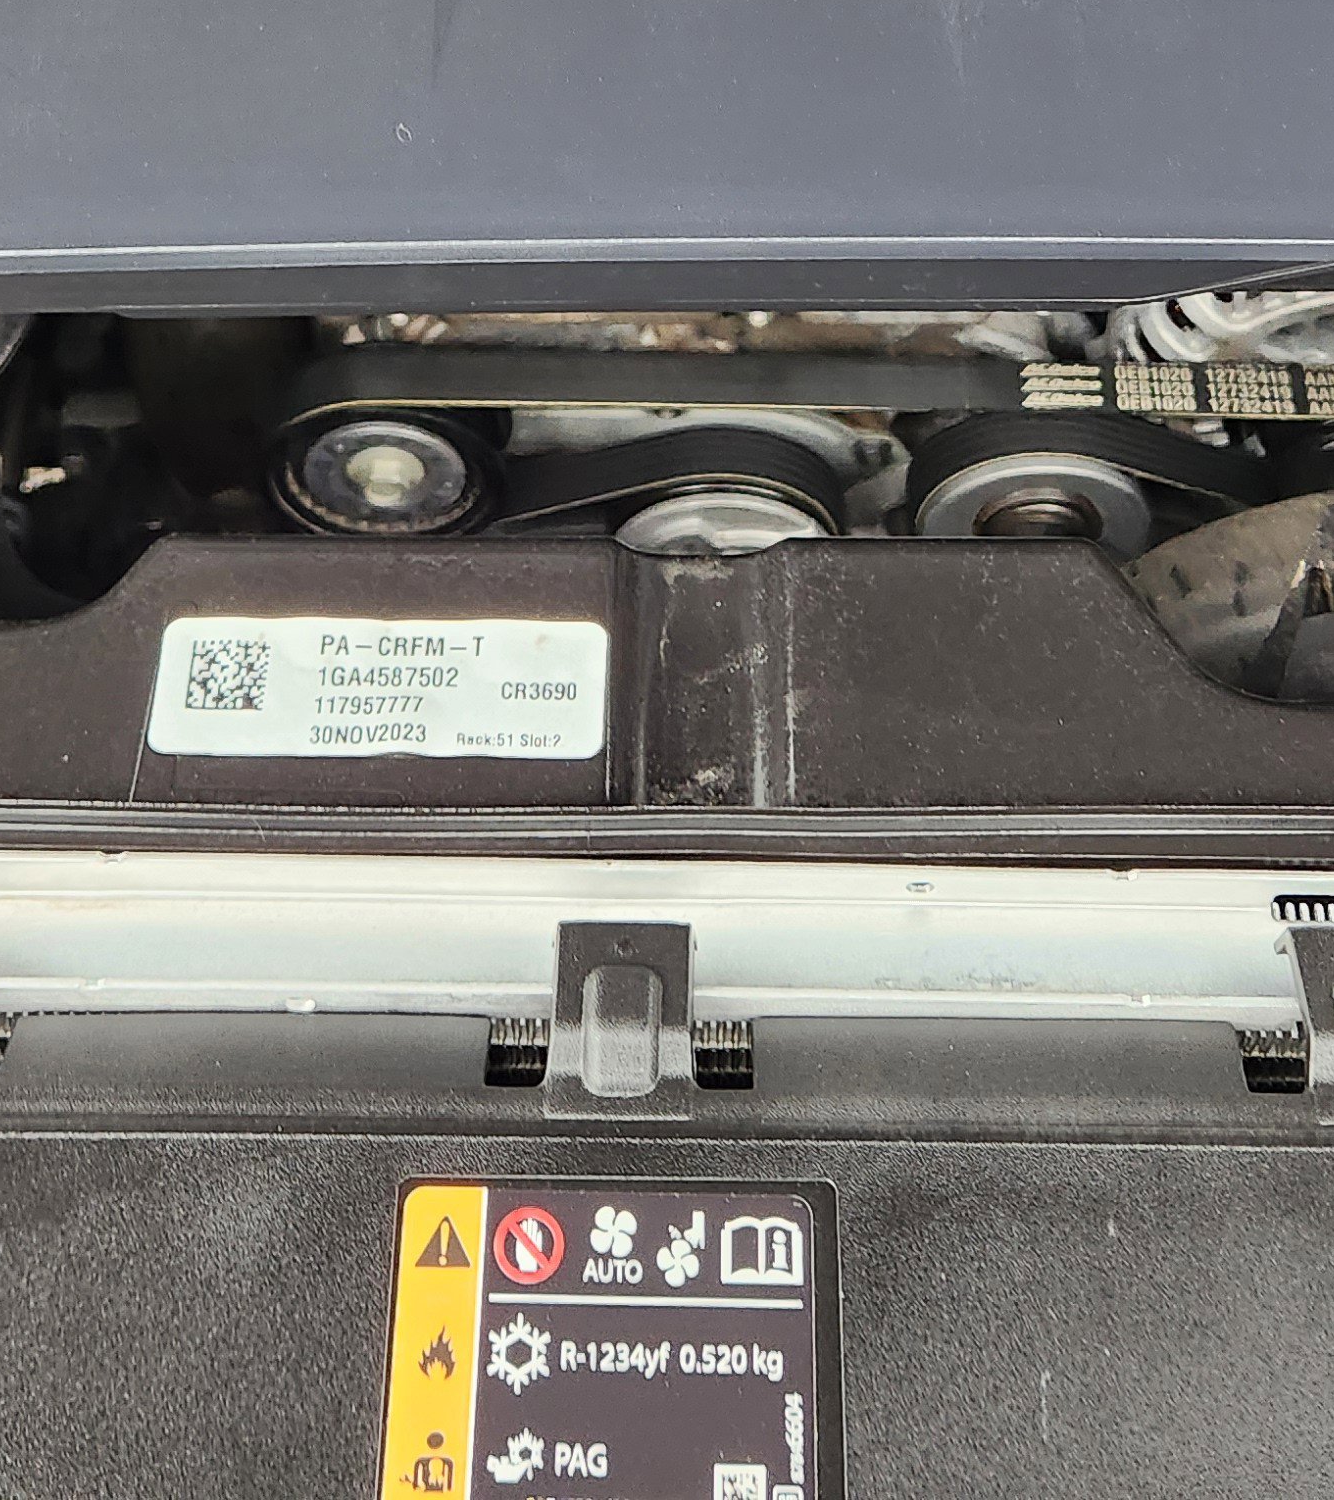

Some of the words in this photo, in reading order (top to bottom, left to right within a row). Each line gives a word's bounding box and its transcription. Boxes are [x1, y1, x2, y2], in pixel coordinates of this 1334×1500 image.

[318, 666, 459, 688] 1GA4587502
[501, 681, 578, 701] CR3690
[315, 695, 424, 715] 117957777
[309, 723, 428, 744] 30NOV2023
[456, 732, 513, 747] Rack:51
[582, 1258, 643, 1284] AUTO
[560, 1340, 671, 1380] R-1234yf
[679, 1343, 748, 1375] 0.520
[752, 1342, 784, 1382] kg
[555, 1442, 608, 1478] PAG
